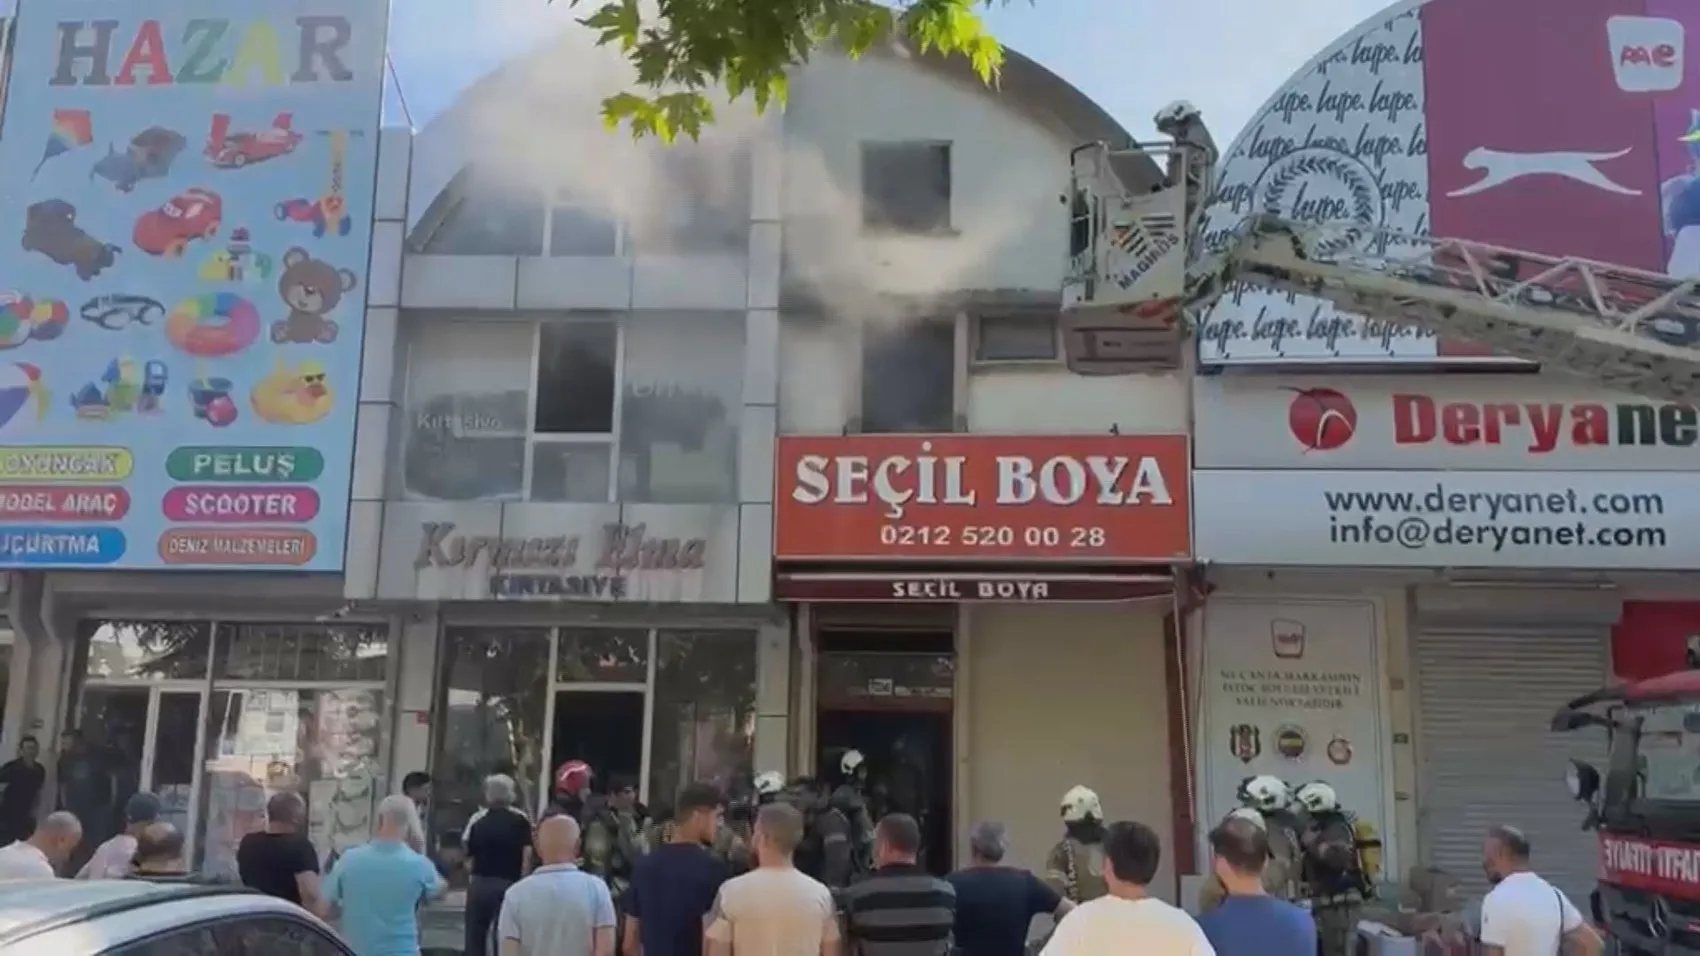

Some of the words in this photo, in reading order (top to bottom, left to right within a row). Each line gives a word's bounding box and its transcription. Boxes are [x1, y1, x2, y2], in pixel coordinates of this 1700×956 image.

[49, 14, 354, 87] HAZAR
[193, 453, 296, 478] PELUŞ
[792, 441, 977, 519] SEÇİL
[996, 455, 1173, 506] BOYA
[62, 492, 118, 516] ARAÇ
[185, 493, 298, 516] SCOOTER
[1325, 484, 1664, 521] www.deryanet.com
[881, 525, 951, 547] 0212
[961, 526, 1014, 547] 520
[1024, 527, 1060, 547] 00
[1070, 527, 1106, 548] 28
[1330, 516, 1666, 552] info@deryanet.com
[978, 582, 1049, 600] BOYA
